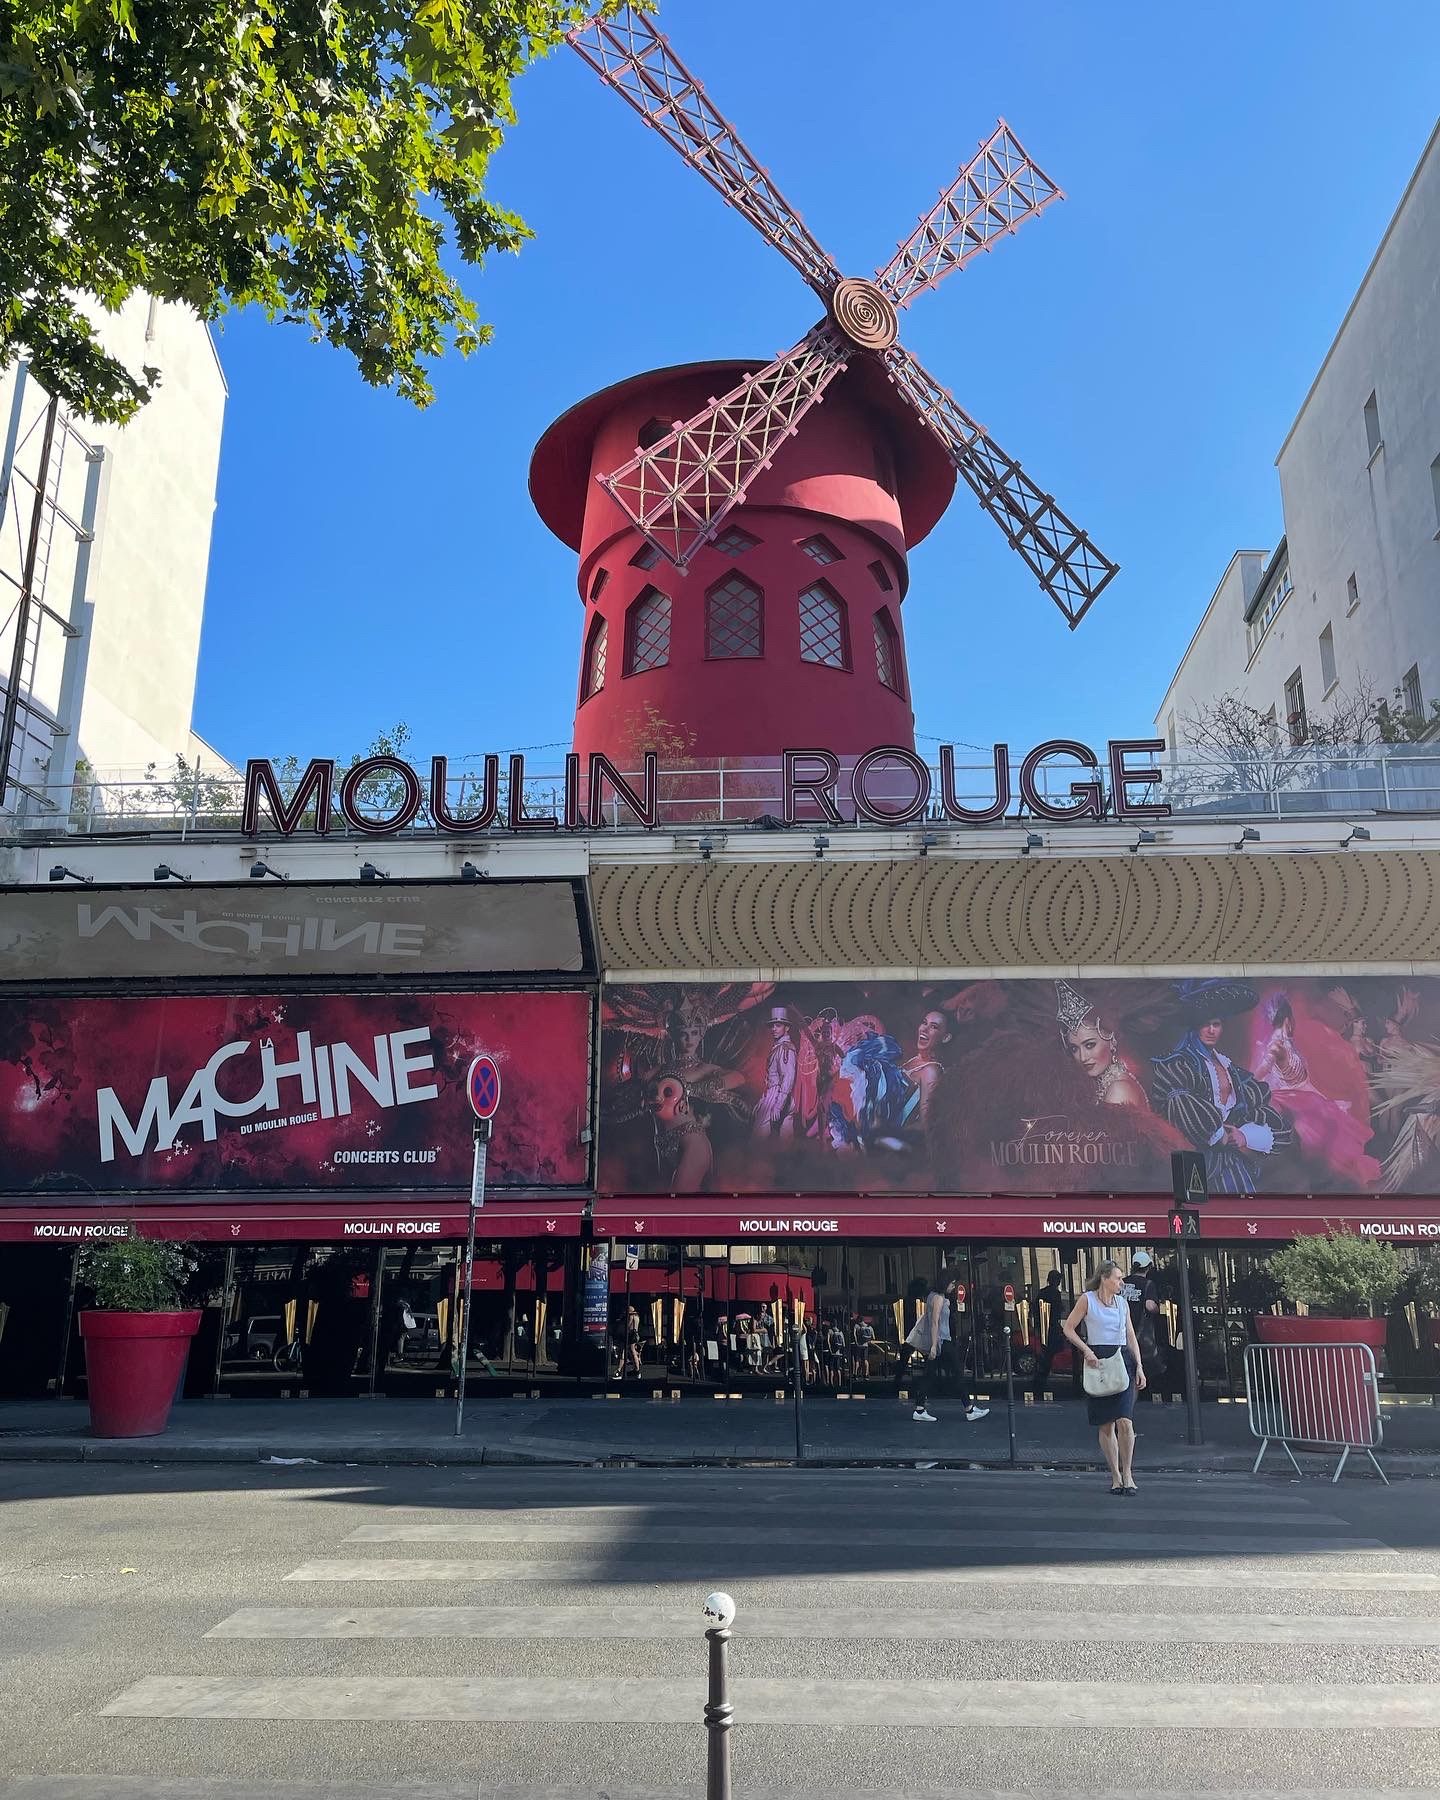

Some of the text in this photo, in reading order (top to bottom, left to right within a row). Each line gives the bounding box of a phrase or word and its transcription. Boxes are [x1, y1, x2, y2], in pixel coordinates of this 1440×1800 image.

[241, 739, 1172, 837] MOULIN ROUGE
[259, 1037, 274, 1049] LA
[97, 1026, 439, 1162] MACHINE
[240, 1112, 318, 1135] DU MOULIN ROUGE
[1010, 1115, 1109, 1150] Forever
[334, 1149, 437, 1164] CONCERTS CLUB
[990, 1141, 1138, 1167] MOULIN ROUGE
[33, 1225, 129, 1237] MOULIN ROUGE
[344, 1222, 441, 1234] MOULIN ROUGE
[740, 1220, 839, 1231] MOULIN ROUGE
[1043, 1222, 1147, 1233] MOULIN ROUGE
[1360, 1223, 1440, 1236] MOULIN RO
